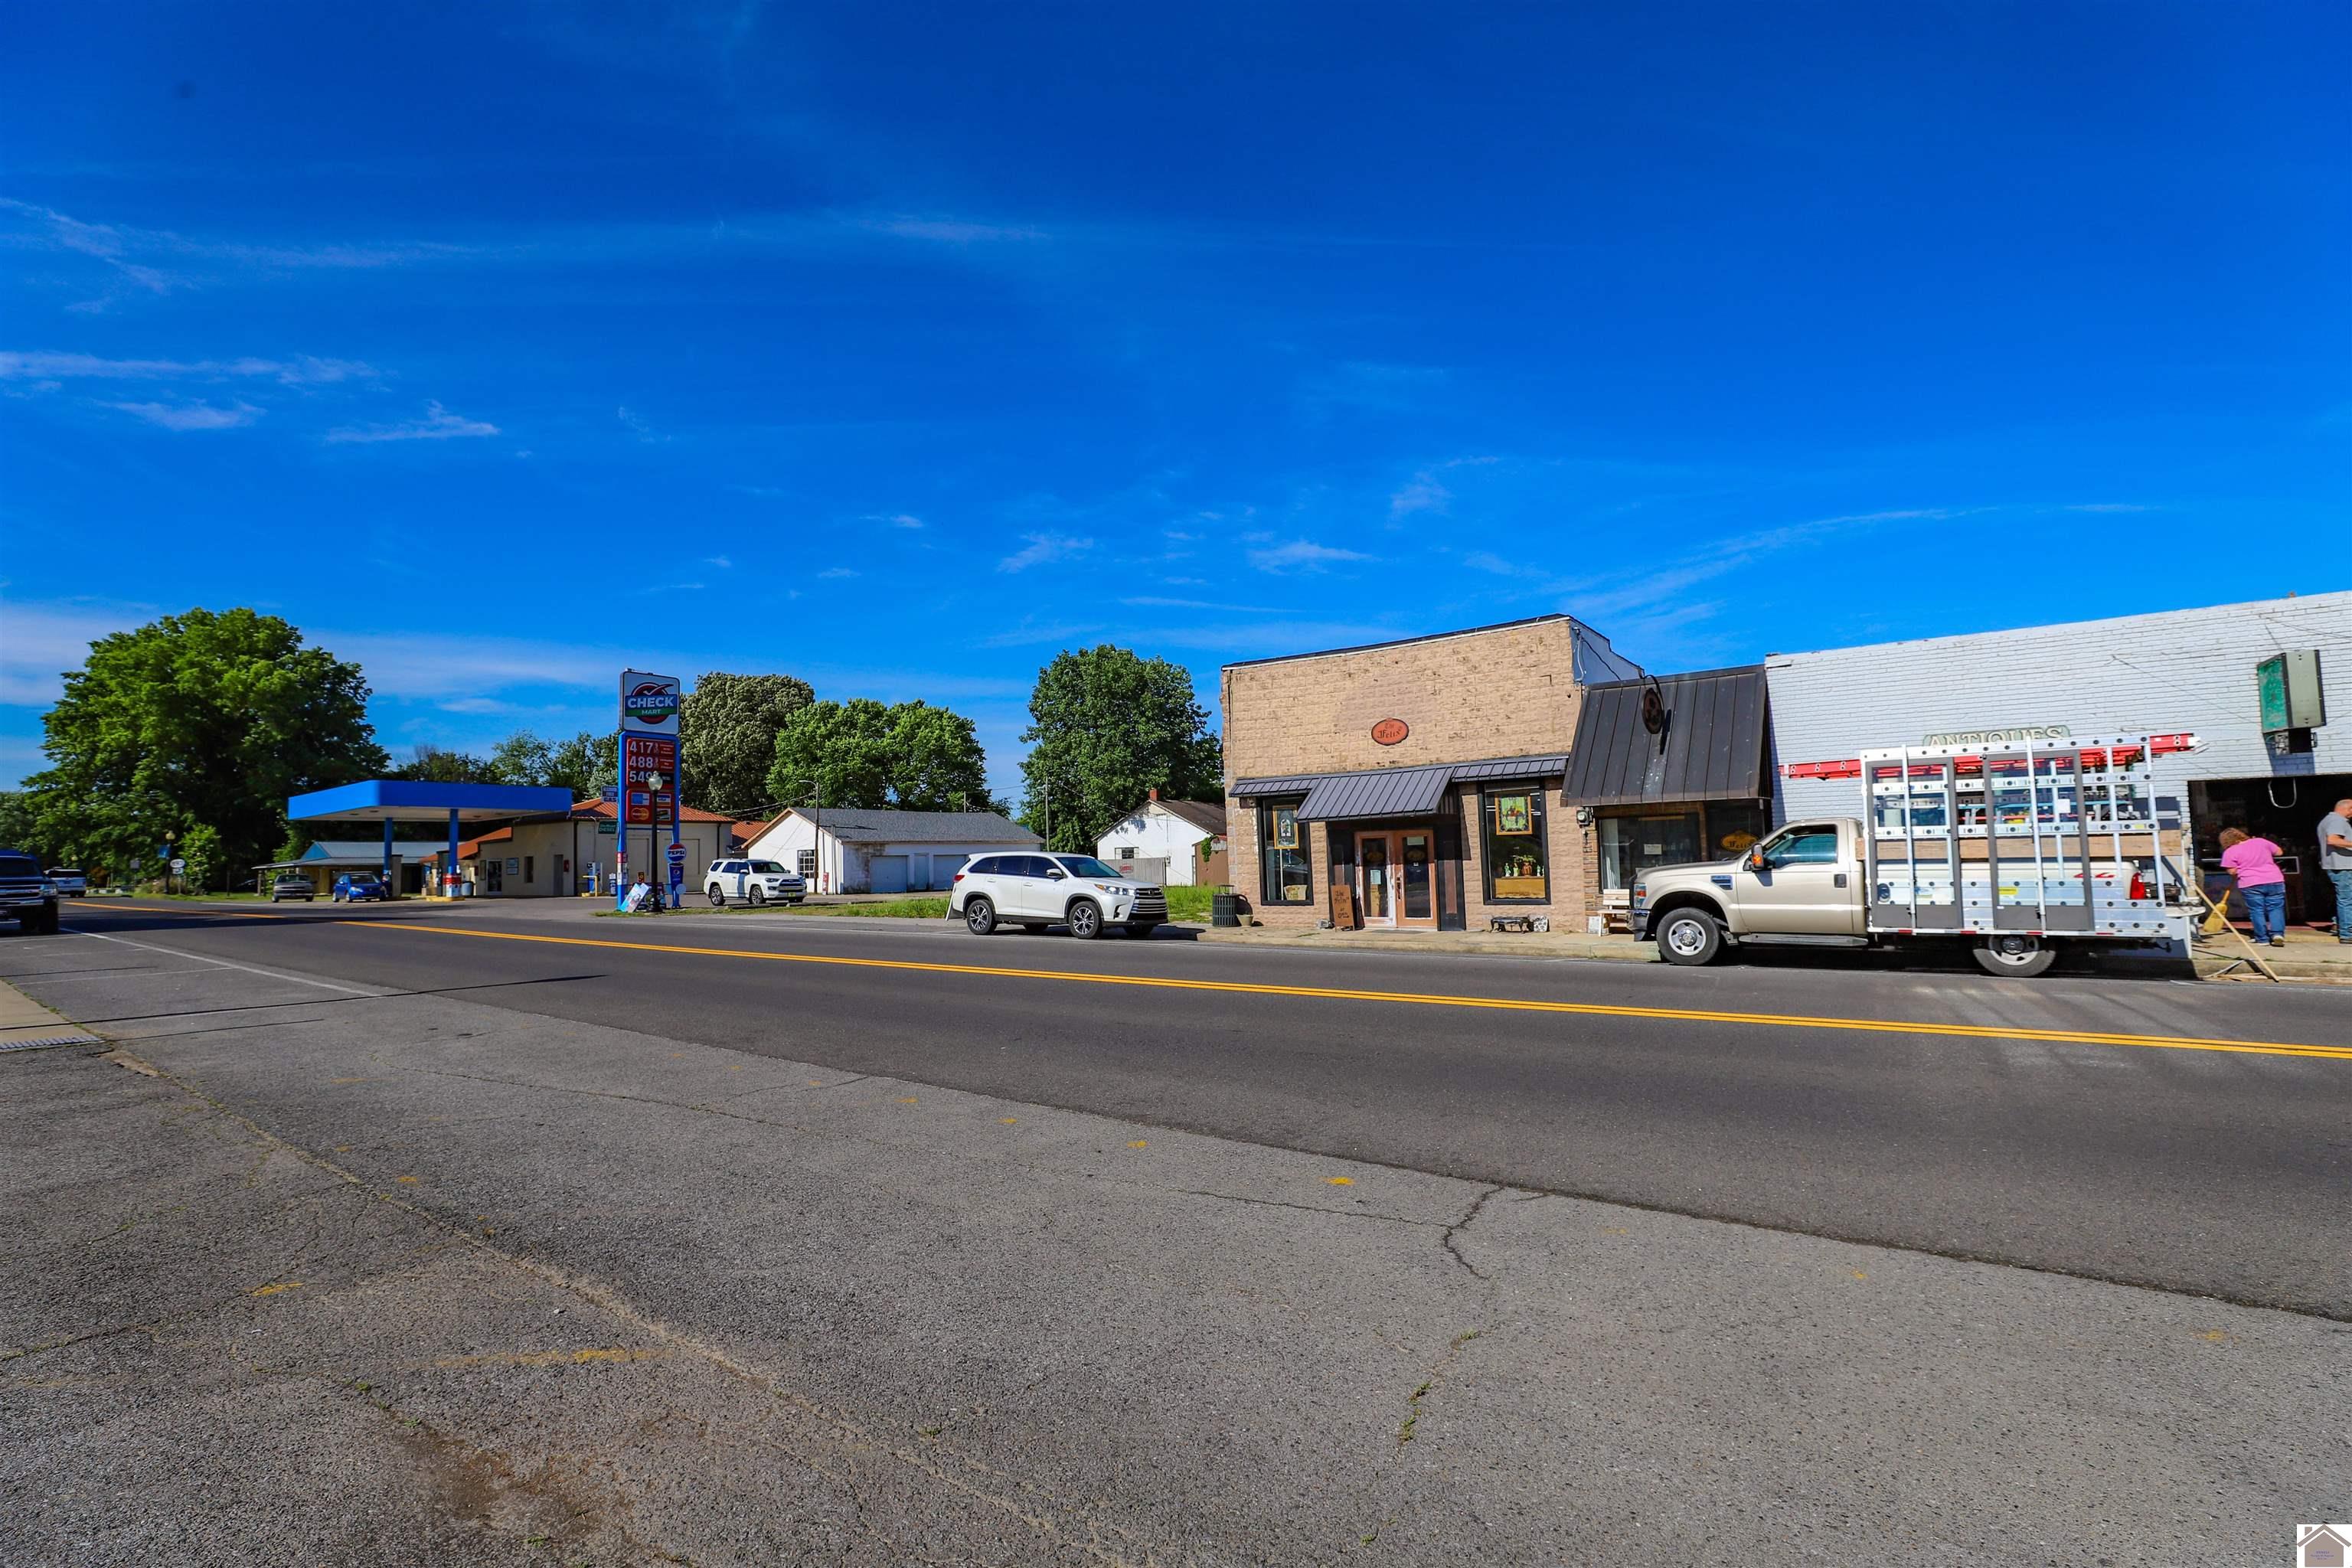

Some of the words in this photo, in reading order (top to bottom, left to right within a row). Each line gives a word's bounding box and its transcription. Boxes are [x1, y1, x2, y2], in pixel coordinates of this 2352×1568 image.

[628, 697, 674, 708] CHECK
[629, 740, 653, 754] 417
[629, 756, 653, 768] 488
